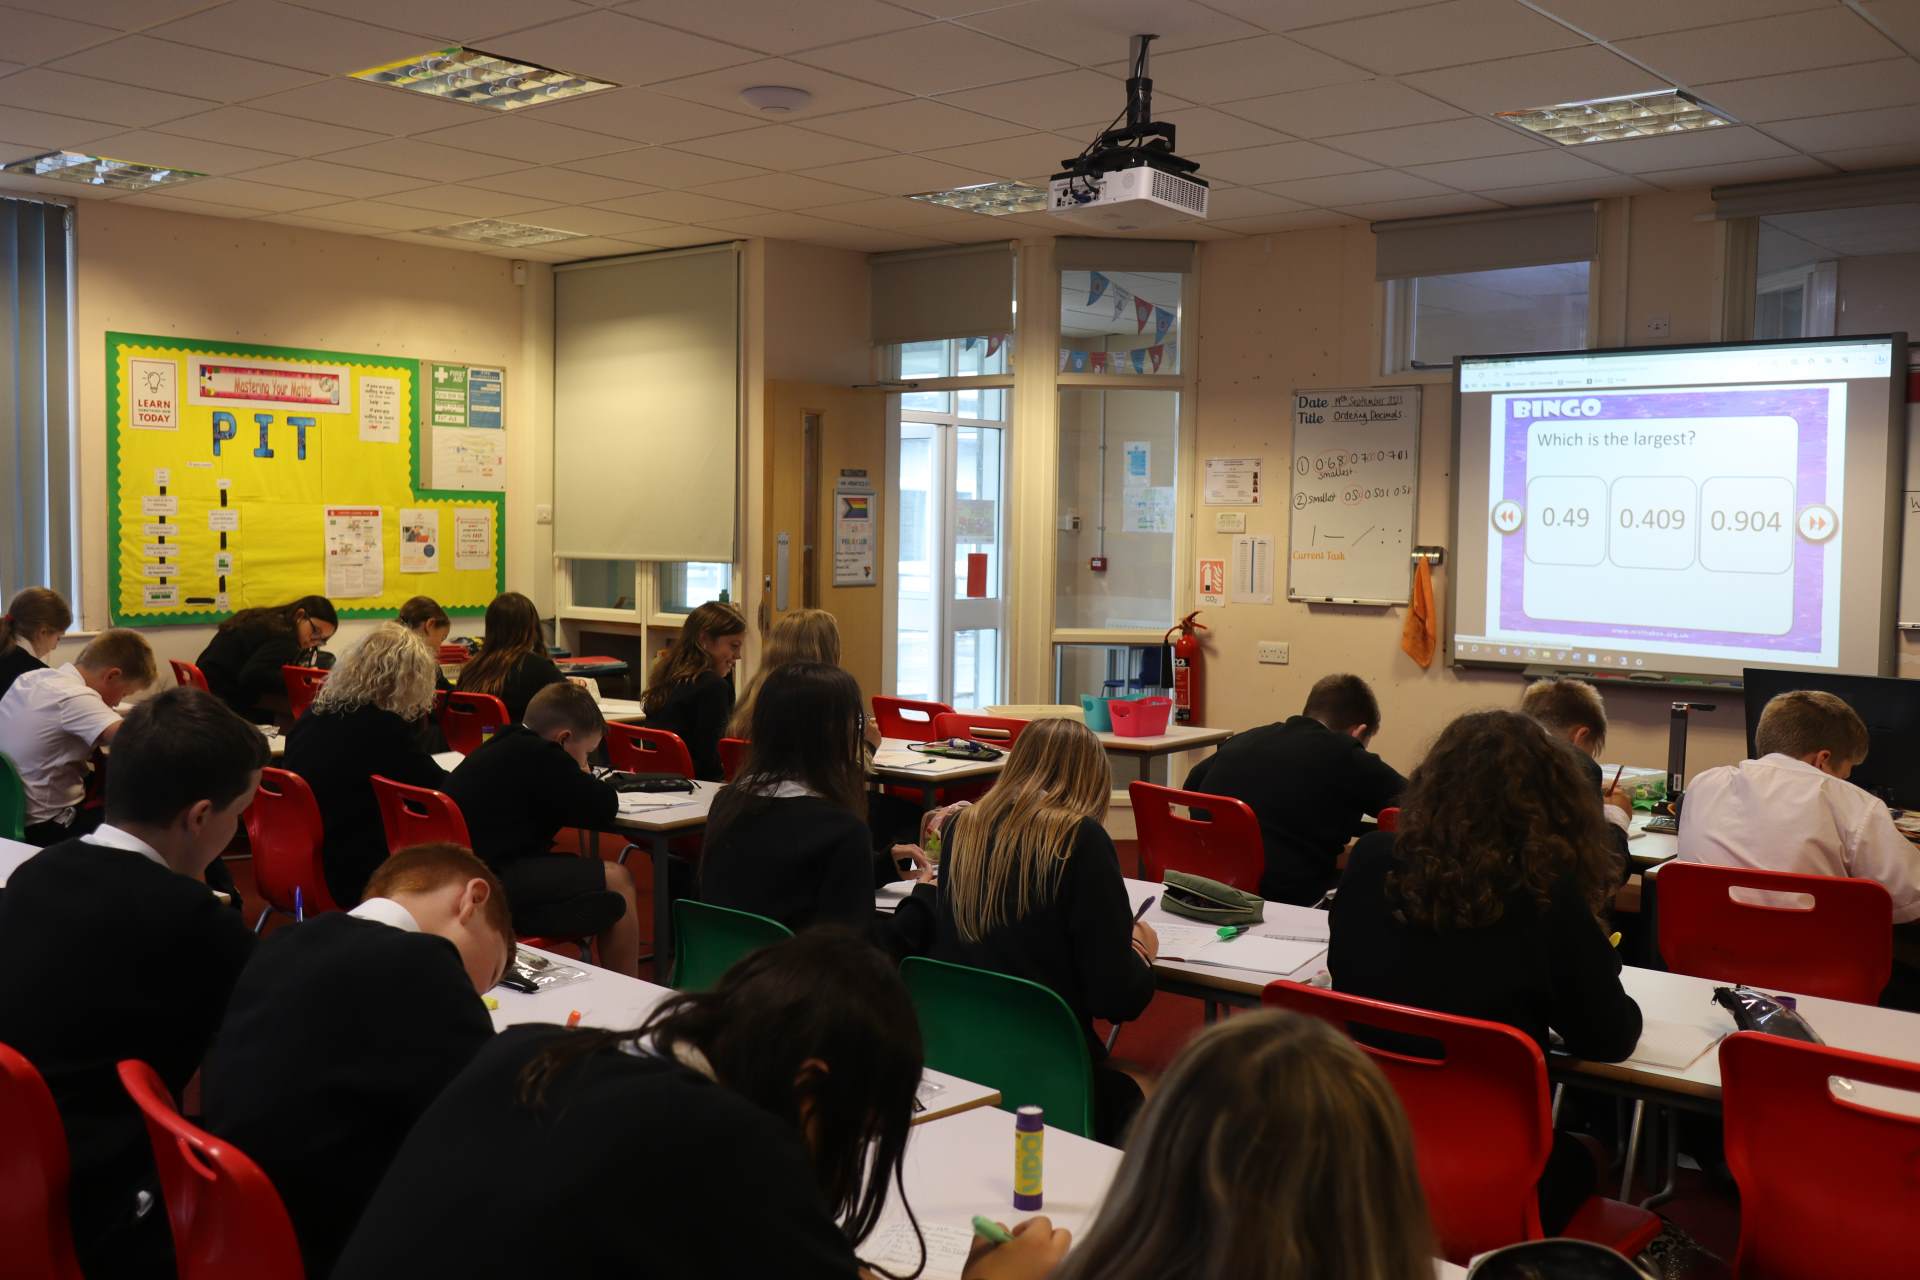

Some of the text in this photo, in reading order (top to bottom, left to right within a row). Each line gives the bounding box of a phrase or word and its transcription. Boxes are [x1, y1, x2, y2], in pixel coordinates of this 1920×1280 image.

[234, 376, 312, 397] Mastering Your Maths
[138, 399, 171, 408] LEARN
[1298, 396, 1329, 408] Date
[1512, 398, 1602, 418] BINGO
[138, 413, 170, 423] TODAY
[1297, 412, 1325, 424] Title
[1334, 410, 1368, 425] Ordering
[1538, 430, 1696, 448] Which is the largest?
[1318, 468, 1353, 480] smallest
[1542, 507, 1590, 528] 0.49
[1620, 508, 1686, 530] 0.409
[1710, 510, 1782, 532] 0.904
[1293, 552, 1324, 560] Current
